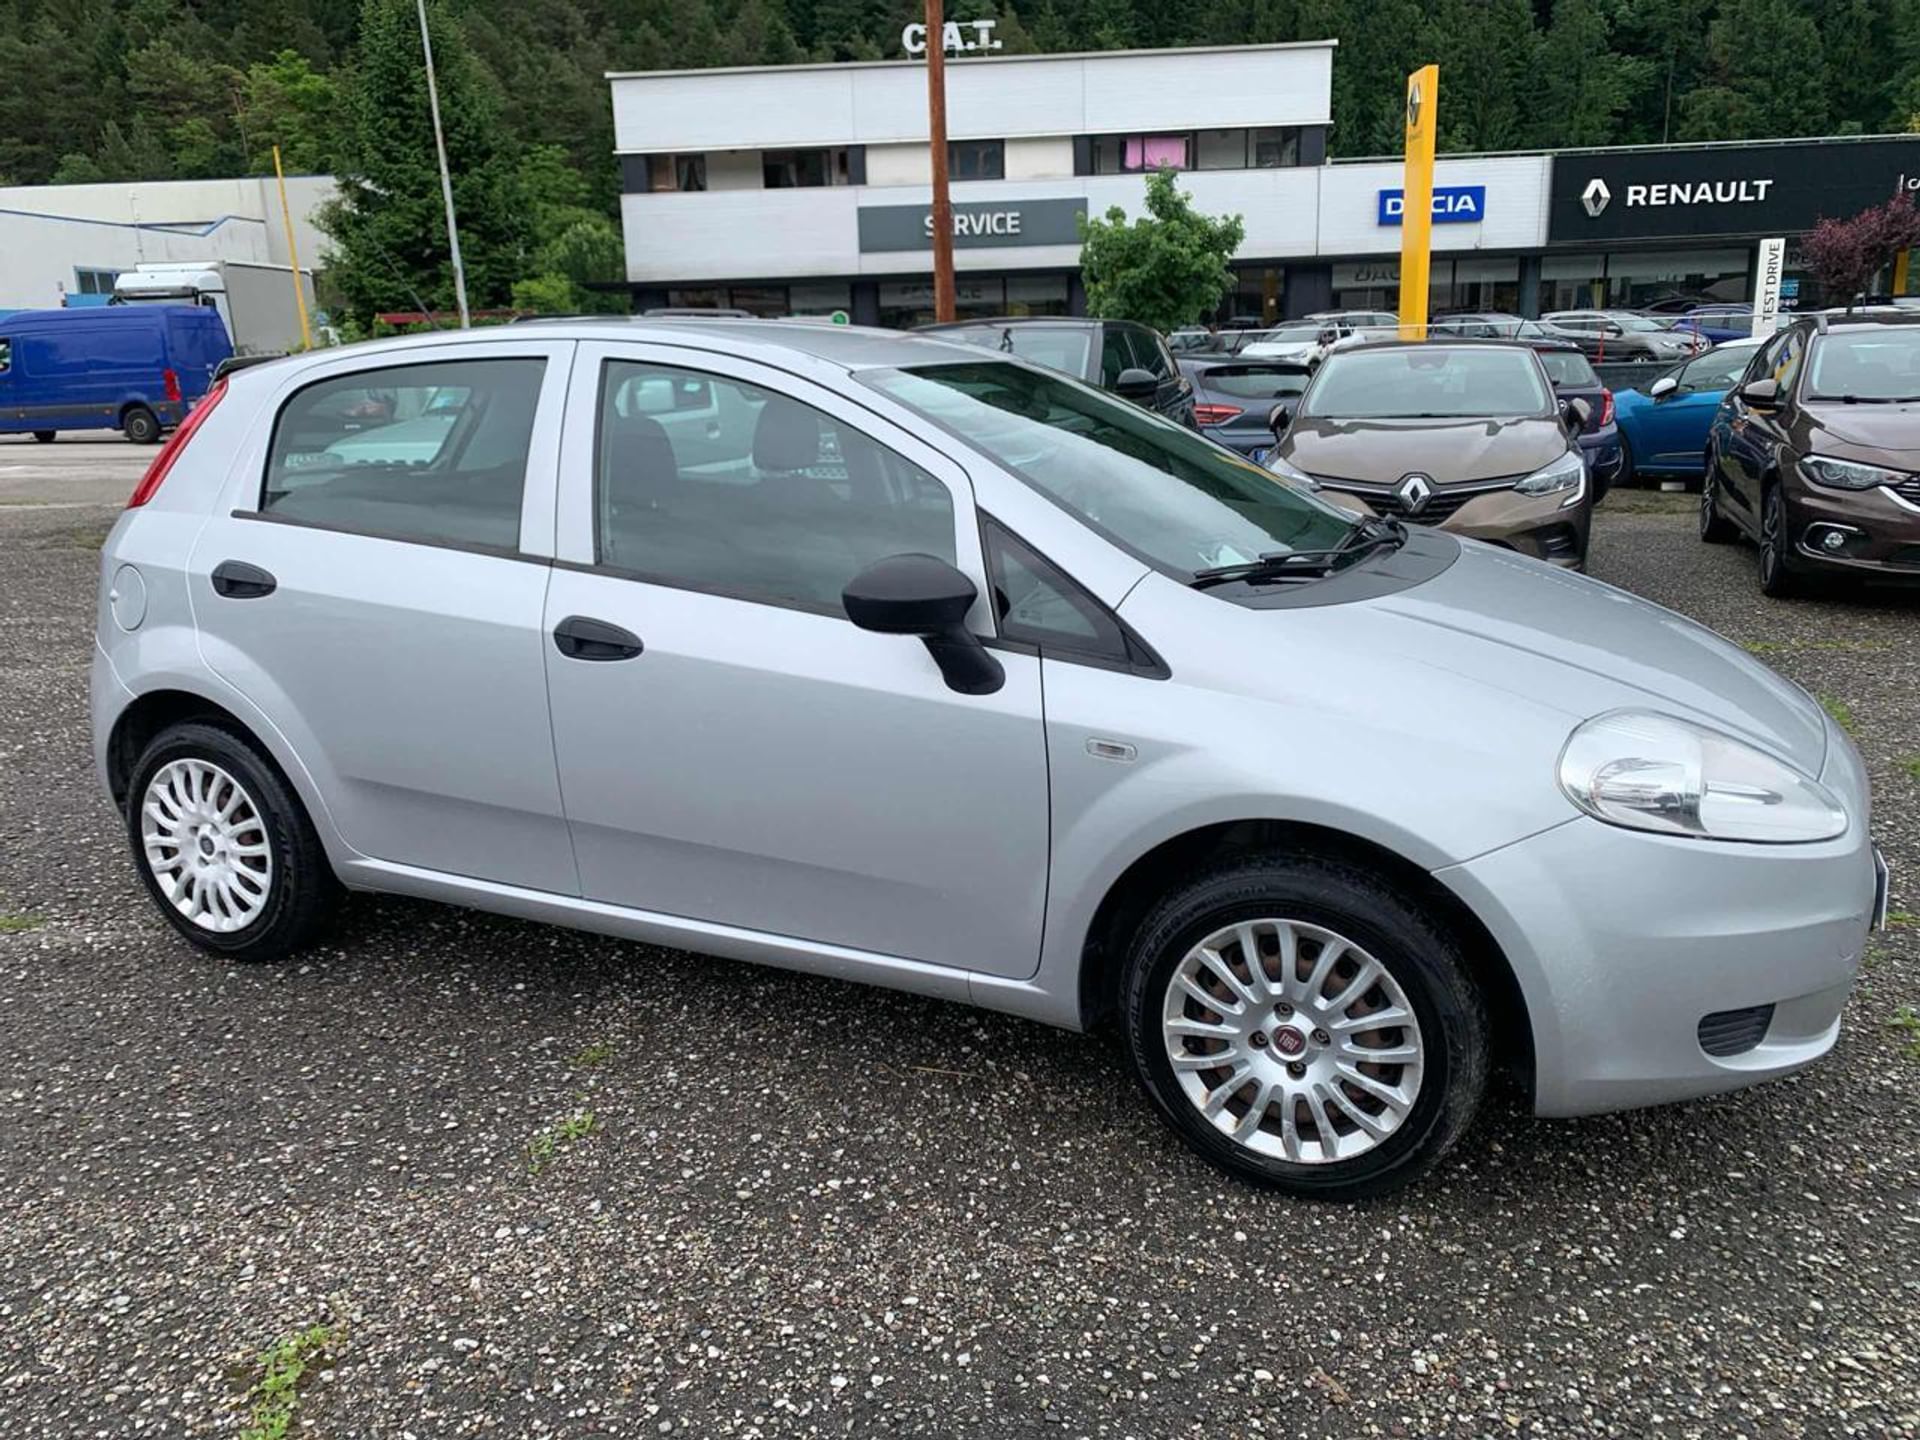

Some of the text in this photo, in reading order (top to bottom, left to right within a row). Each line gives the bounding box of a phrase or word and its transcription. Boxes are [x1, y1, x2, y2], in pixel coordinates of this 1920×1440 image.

[1386, 195, 1477, 216] DCIA
[1626, 179, 1773, 207] RENAULT
[923, 212, 1021, 237] SRVICE
[1763, 243, 1780, 323] TEST DRIVE
